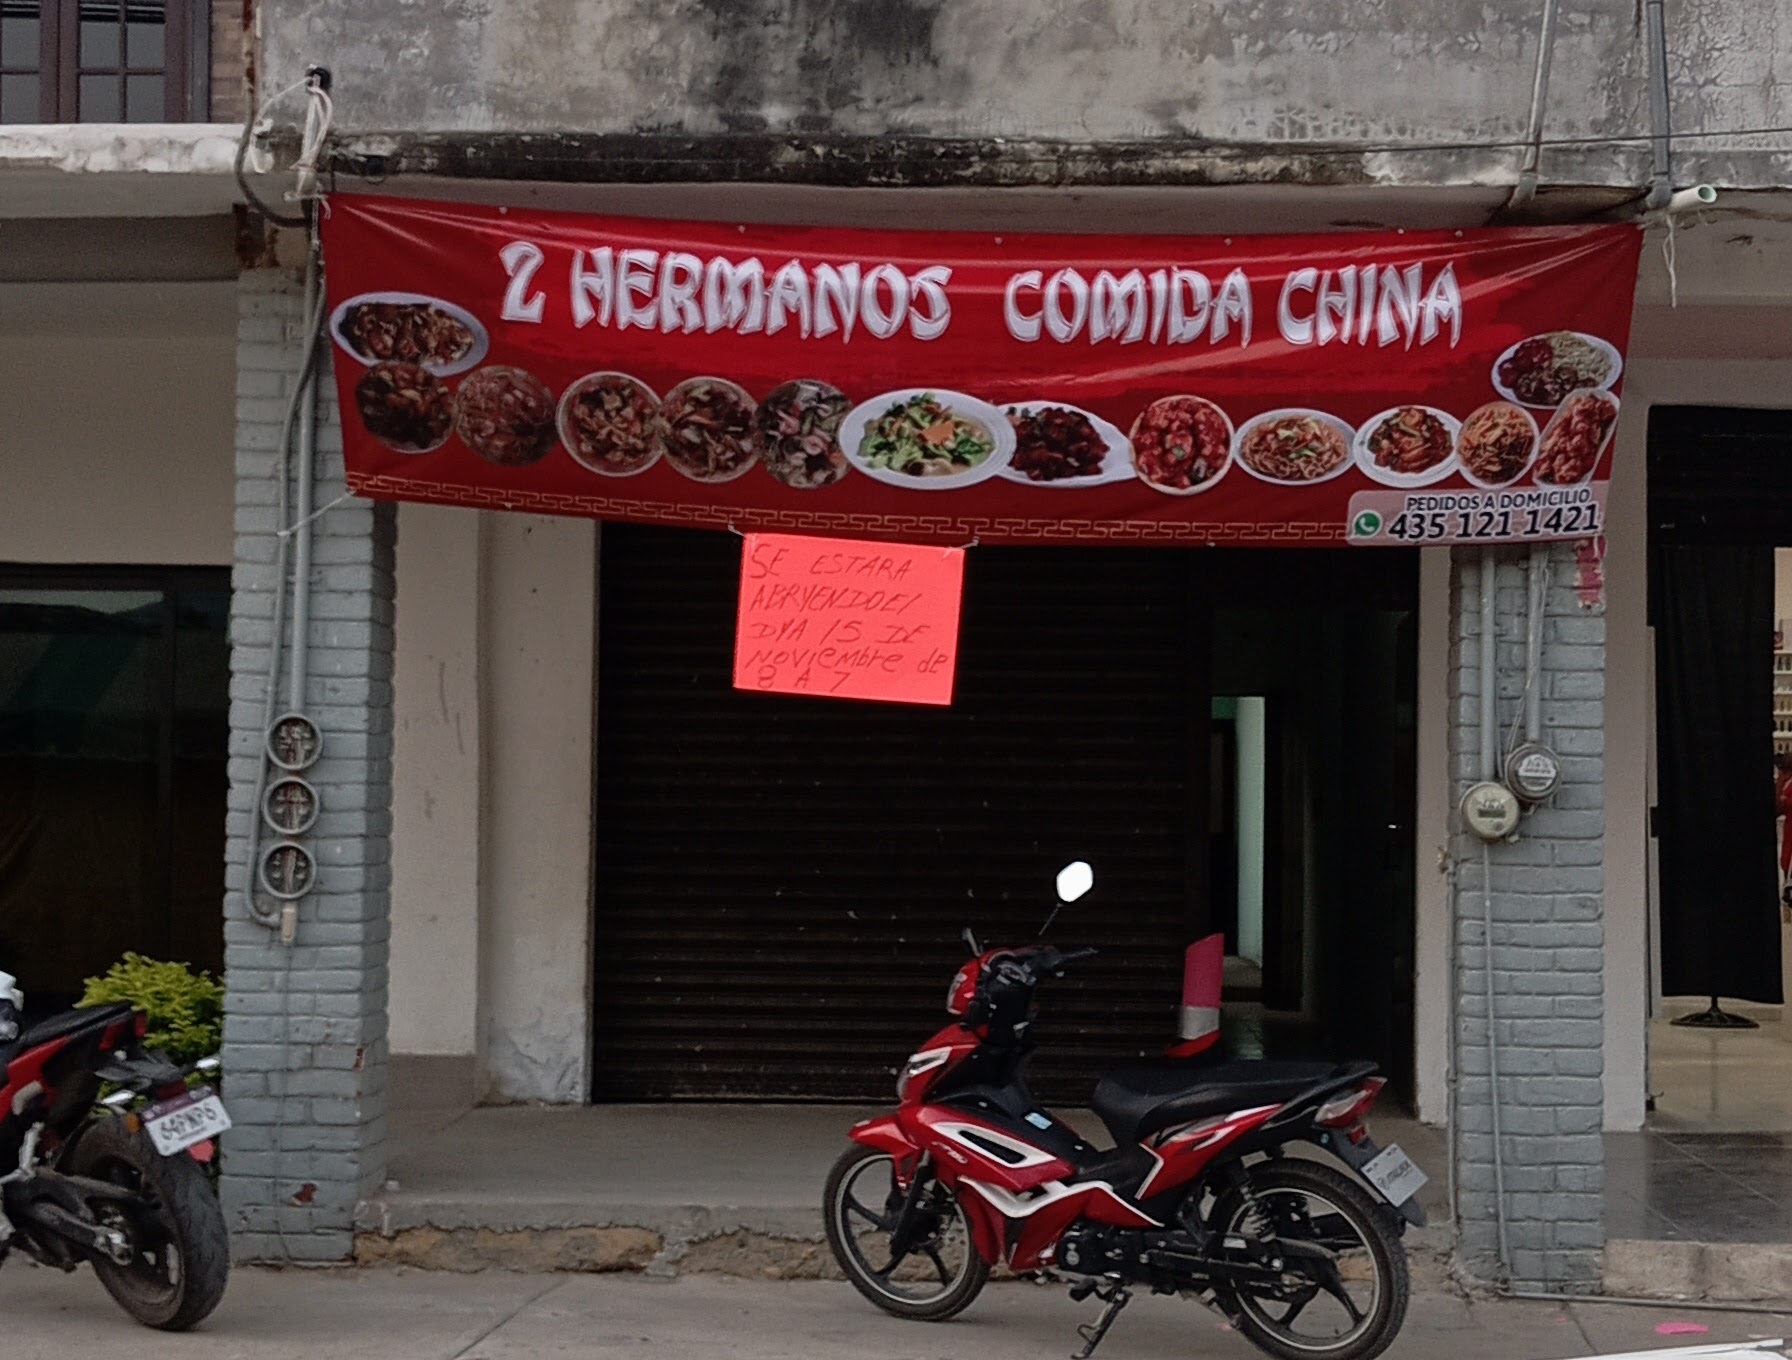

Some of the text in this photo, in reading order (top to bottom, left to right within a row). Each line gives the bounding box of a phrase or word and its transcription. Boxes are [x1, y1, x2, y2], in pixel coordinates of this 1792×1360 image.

[499, 241, 1463, 352] 2 HERMANOS COMIDA CHINA
[1406, 488, 1591, 512] PEDIDOS A DOMICILIO
[1388, 504, 1600, 539] 435 121 1421
[750, 542, 913, 581] SE ESTARA
[819, 618, 862, 645] 15
[794, 667, 811, 688] A
[830, 670, 851, 693] 7
